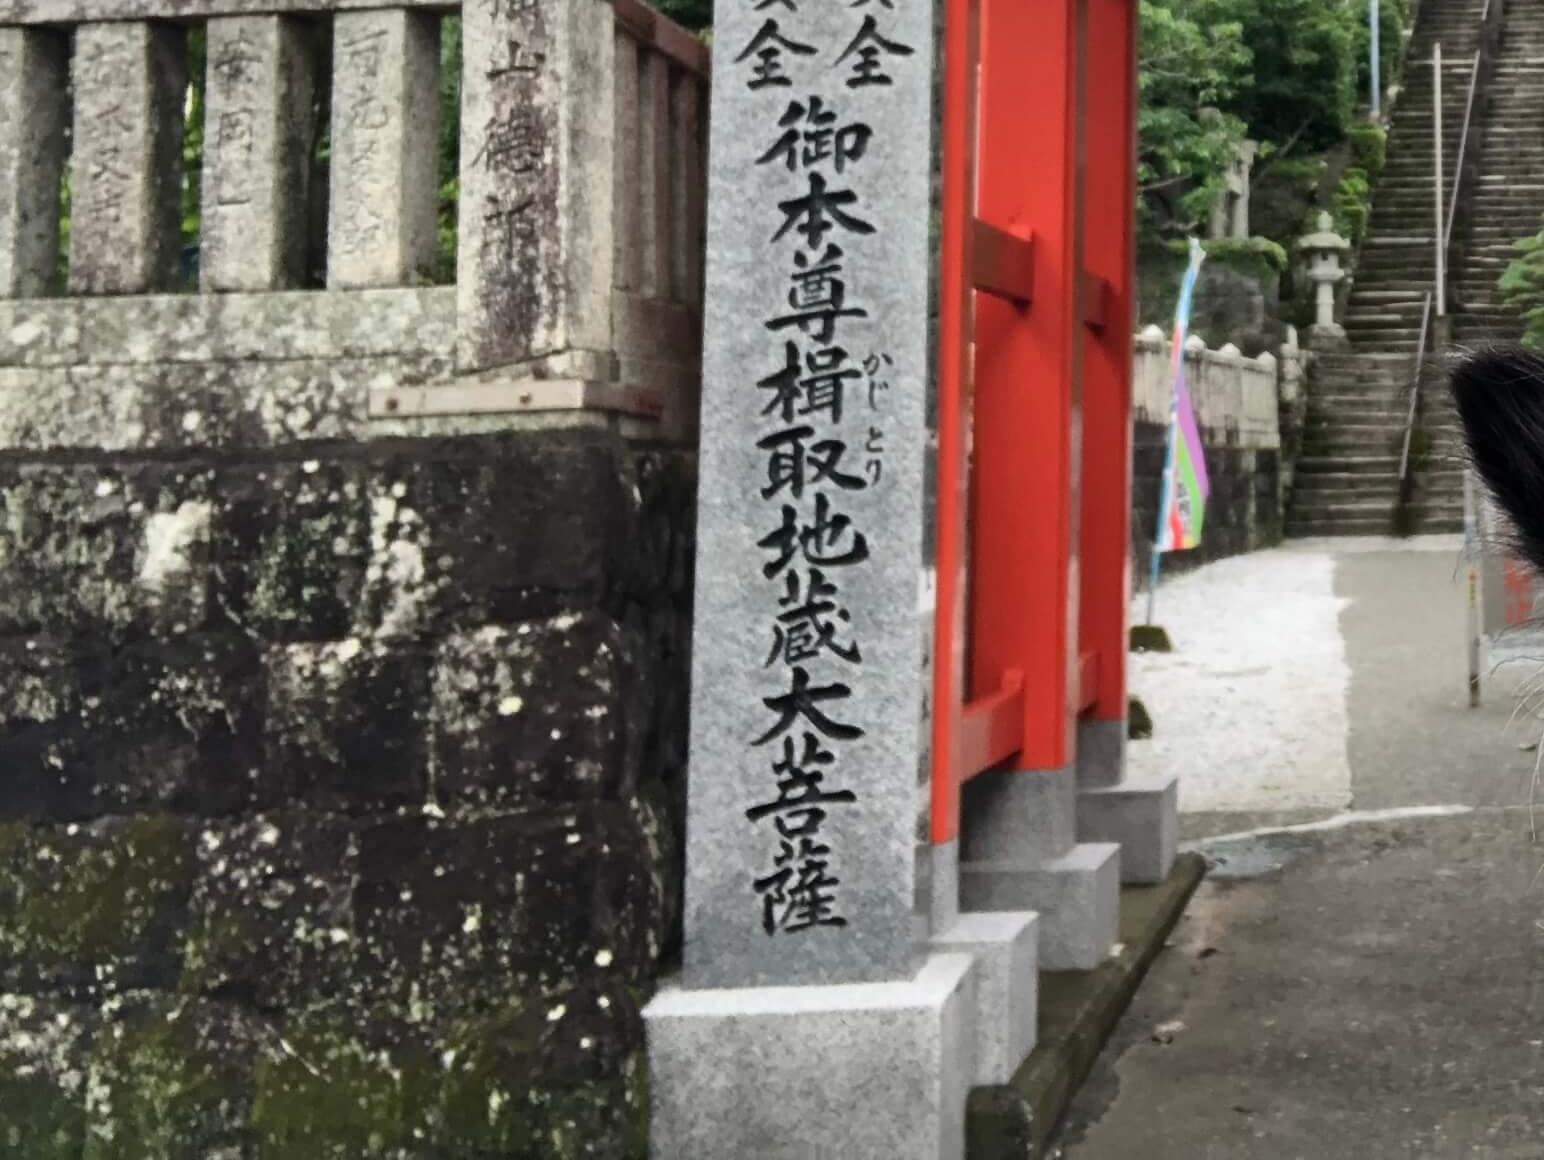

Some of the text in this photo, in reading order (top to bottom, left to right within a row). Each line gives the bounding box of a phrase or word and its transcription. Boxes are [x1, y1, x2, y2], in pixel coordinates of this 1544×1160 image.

[746, 96, 876, 937] 御本尊楫取地蔵大菩薩
